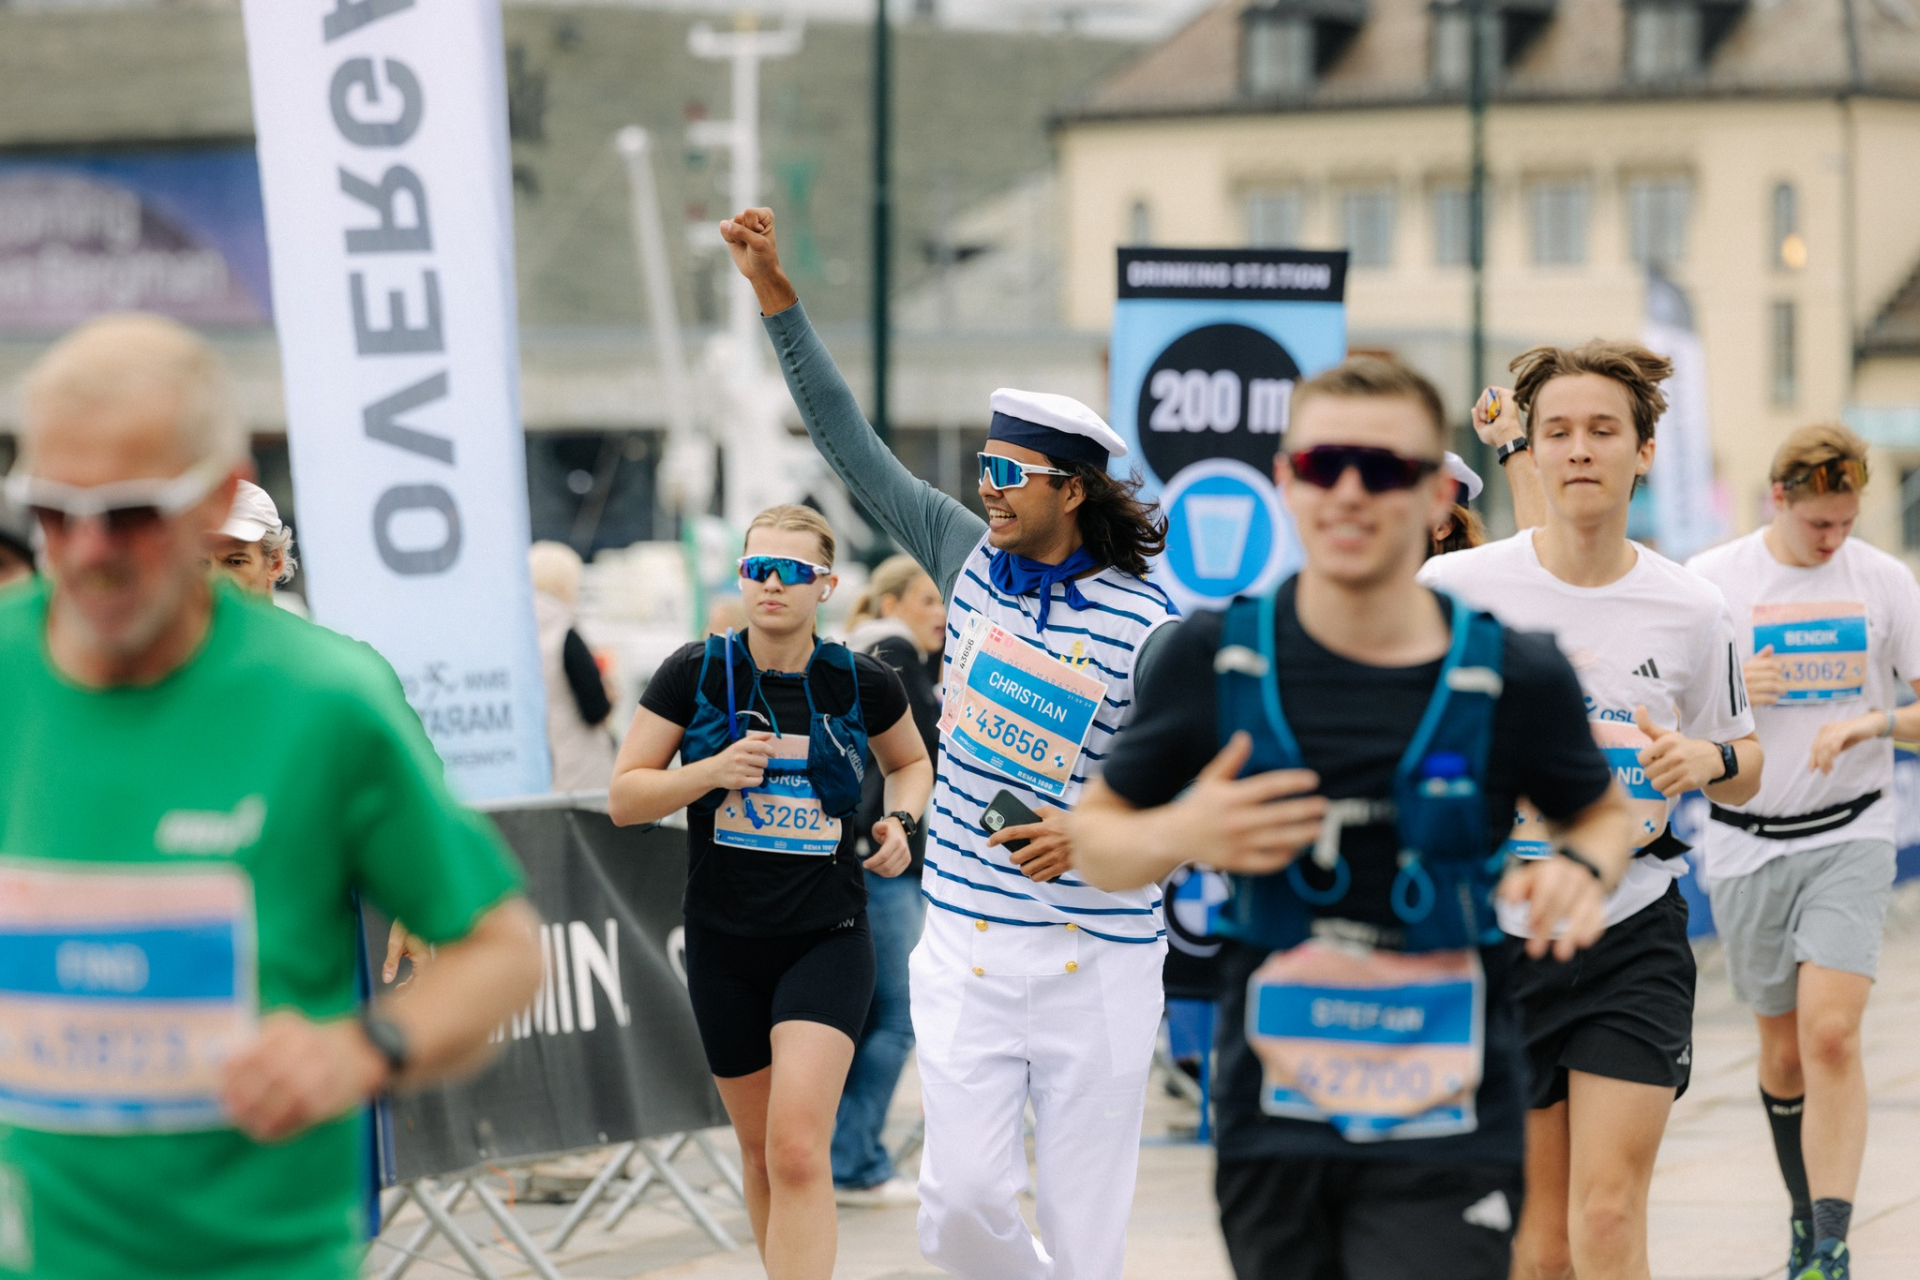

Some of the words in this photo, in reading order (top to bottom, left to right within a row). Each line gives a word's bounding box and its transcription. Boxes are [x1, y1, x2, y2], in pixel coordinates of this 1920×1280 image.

[1127, 261, 1231, 288] DRINKING
[1232, 262, 1331, 290] STATION
[1150, 369, 1242, 434] 200
[1247, 378, 1295, 434] m
[1784, 629, 1839, 646] BENDIK
[960, 638, 975, 669] 43656
[988, 671, 1068, 723] CHRISTIAN
[1036, 671, 1086, 698] MARATON
[1600, 708, 1637, 724] OSL
[975, 708, 1049, 762] 43656
[1017, 770, 1037, 783] REMA
[761, 803, 821, 830] 3262
